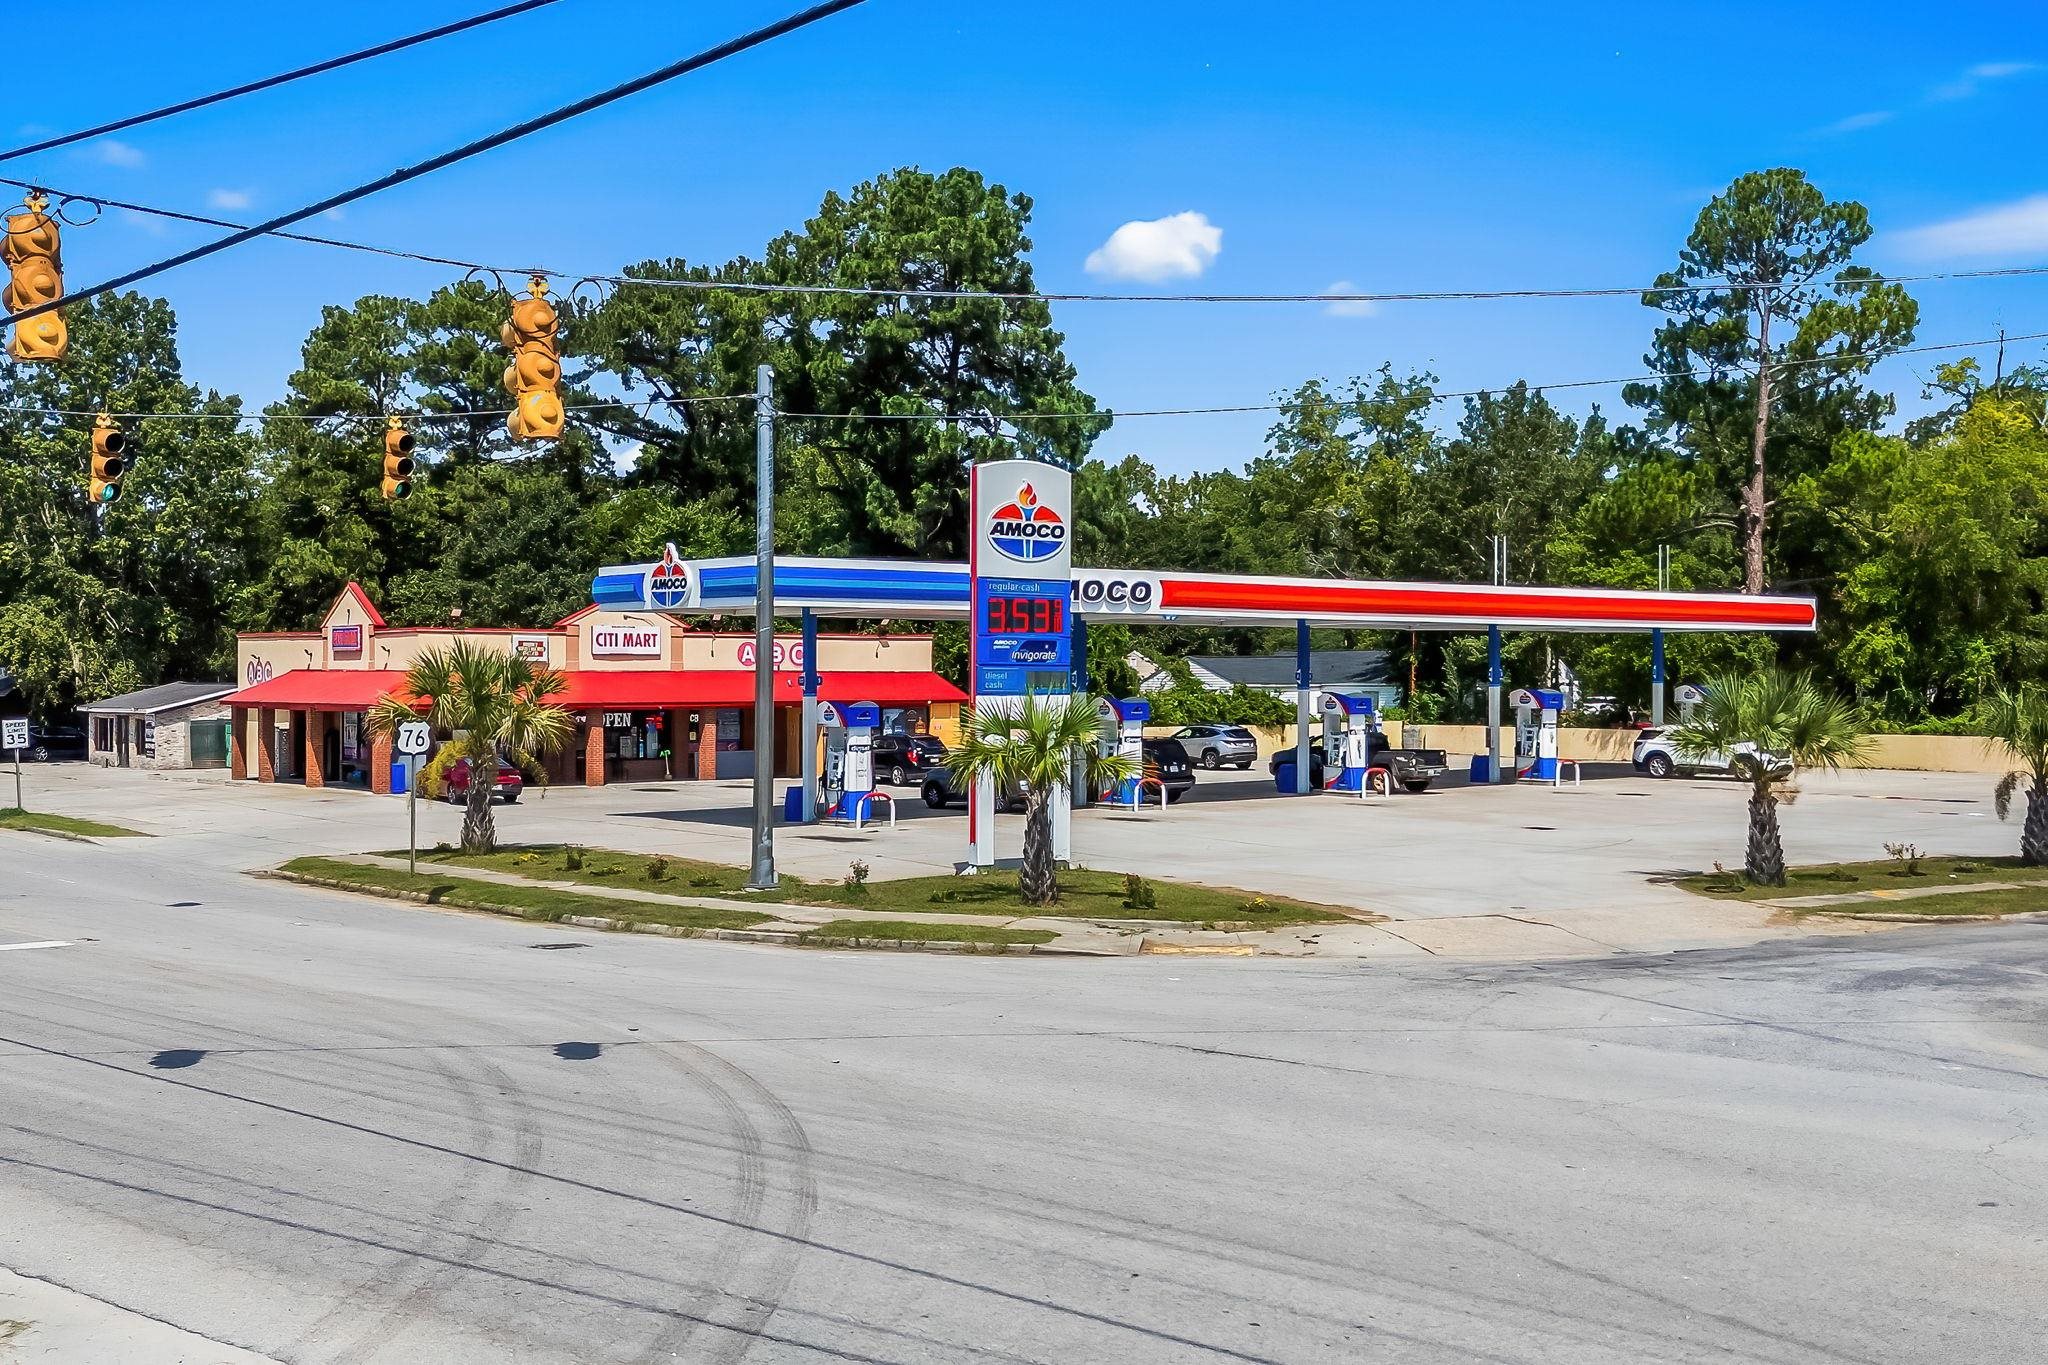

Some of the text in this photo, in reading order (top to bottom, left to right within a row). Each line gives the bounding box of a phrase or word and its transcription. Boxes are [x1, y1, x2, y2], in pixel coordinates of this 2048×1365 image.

[990, 521, 1065, 539] AMOCO
[651, 577, 688, 590] AMOCO
[595, 632, 658, 648] CITI MART
[1011, 650, 1057, 663] Invigorate
[6, 733, 27, 745] 35
[403, 729, 426, 748] 76
